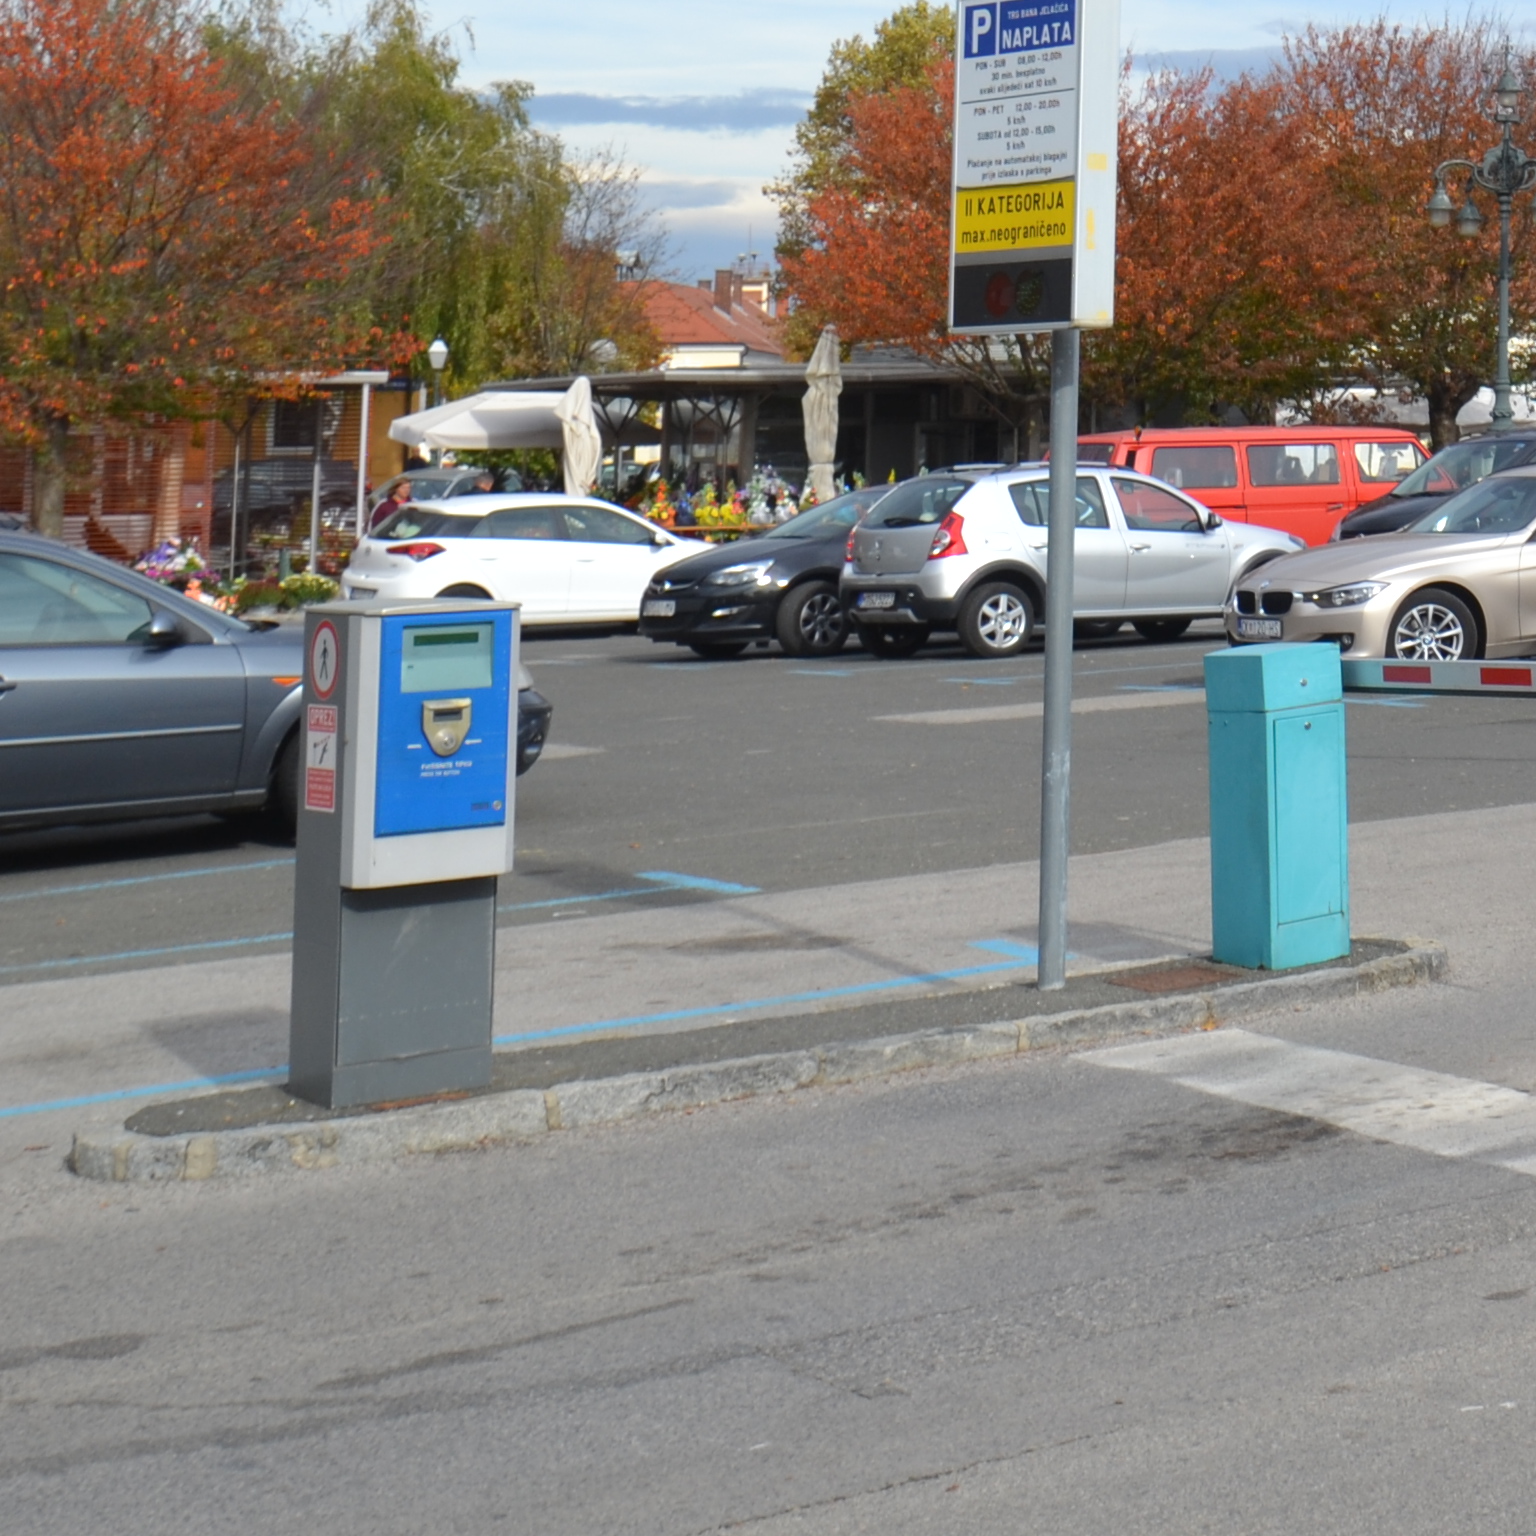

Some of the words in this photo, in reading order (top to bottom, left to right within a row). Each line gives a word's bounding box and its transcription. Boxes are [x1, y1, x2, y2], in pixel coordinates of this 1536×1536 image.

[1021, 8, 1037, 19] BANA
[972, 9, 992, 54] P
[1002, 21, 1071, 49] NAPLATA
[976, 62, 987, 70] PON
[974, 107, 986, 116] PON
[992, 105, 1004, 114] PET
[977, 130, 1001, 141] SUBOTA
[1026, 167, 1051, 177] parkinga
[965, 199, 972, 216] II
[978, 190, 1064, 215] KATEGORIJA
[962, 220, 1066, 245] max.neograničeno
